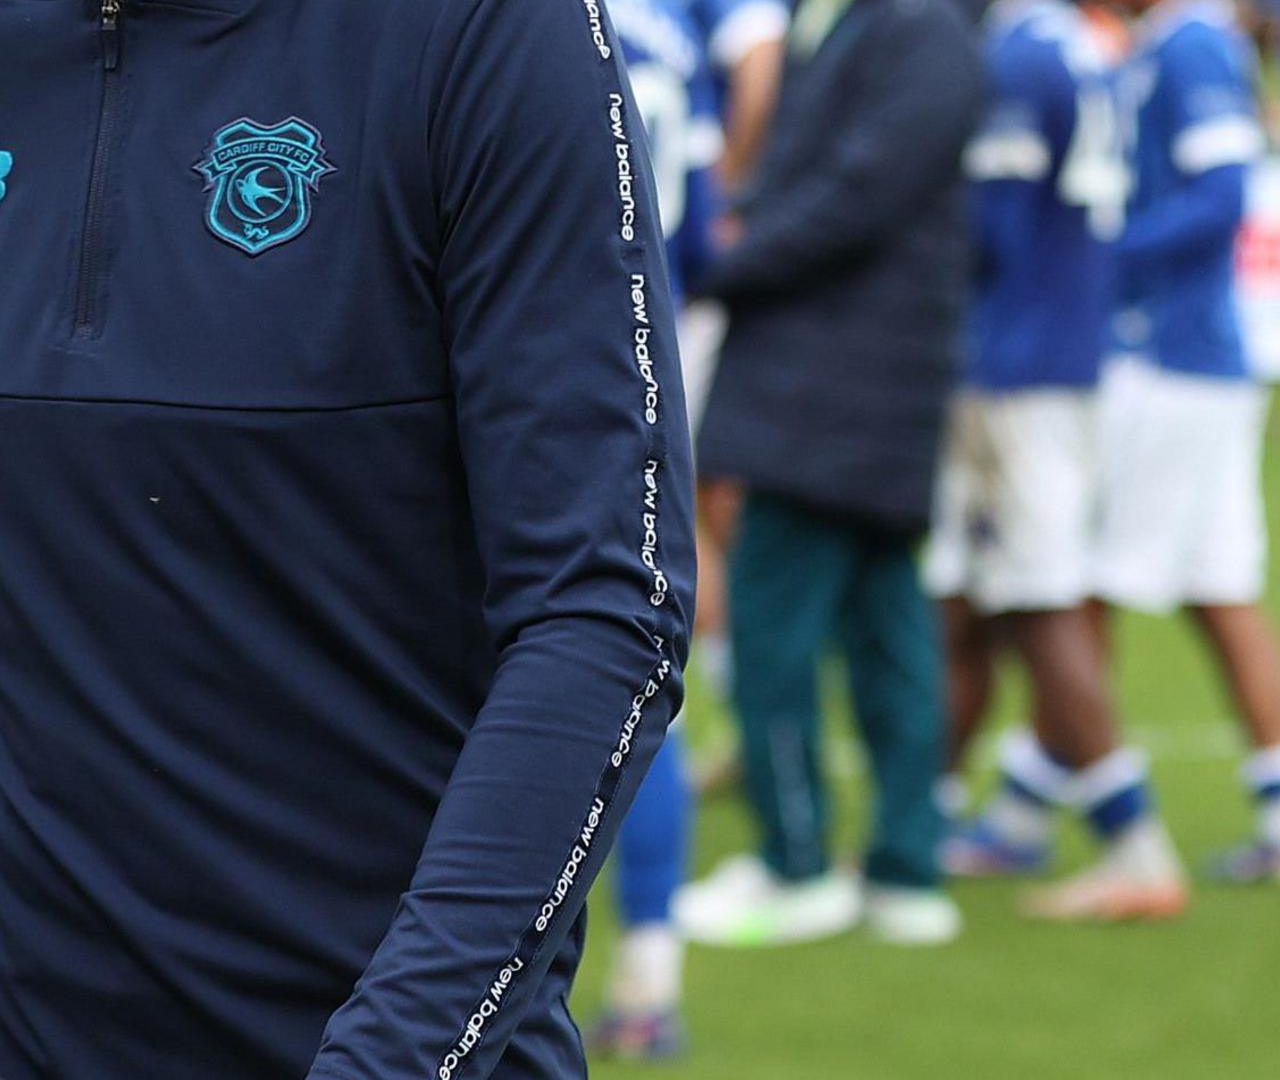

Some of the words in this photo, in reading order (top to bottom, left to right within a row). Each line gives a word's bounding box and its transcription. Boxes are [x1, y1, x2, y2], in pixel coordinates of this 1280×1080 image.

[609, 93, 626, 140] new
[217, 142, 266, 162] CARDIFF
[266, 142, 295, 157] CITY
[293, 149, 310, 163] FC
[616, 144, 634, 241] balance
[631, 274, 649, 324] new
[634, 327, 658, 425] balance
[644, 460, 660, 510] new
[653, 635, 670, 680] nw
[581, 797, 605, 847] new
[535, 845, 587, 932] balance
[490, 957, 525, 1002] new
[438, 998, 498, 1080] balance
